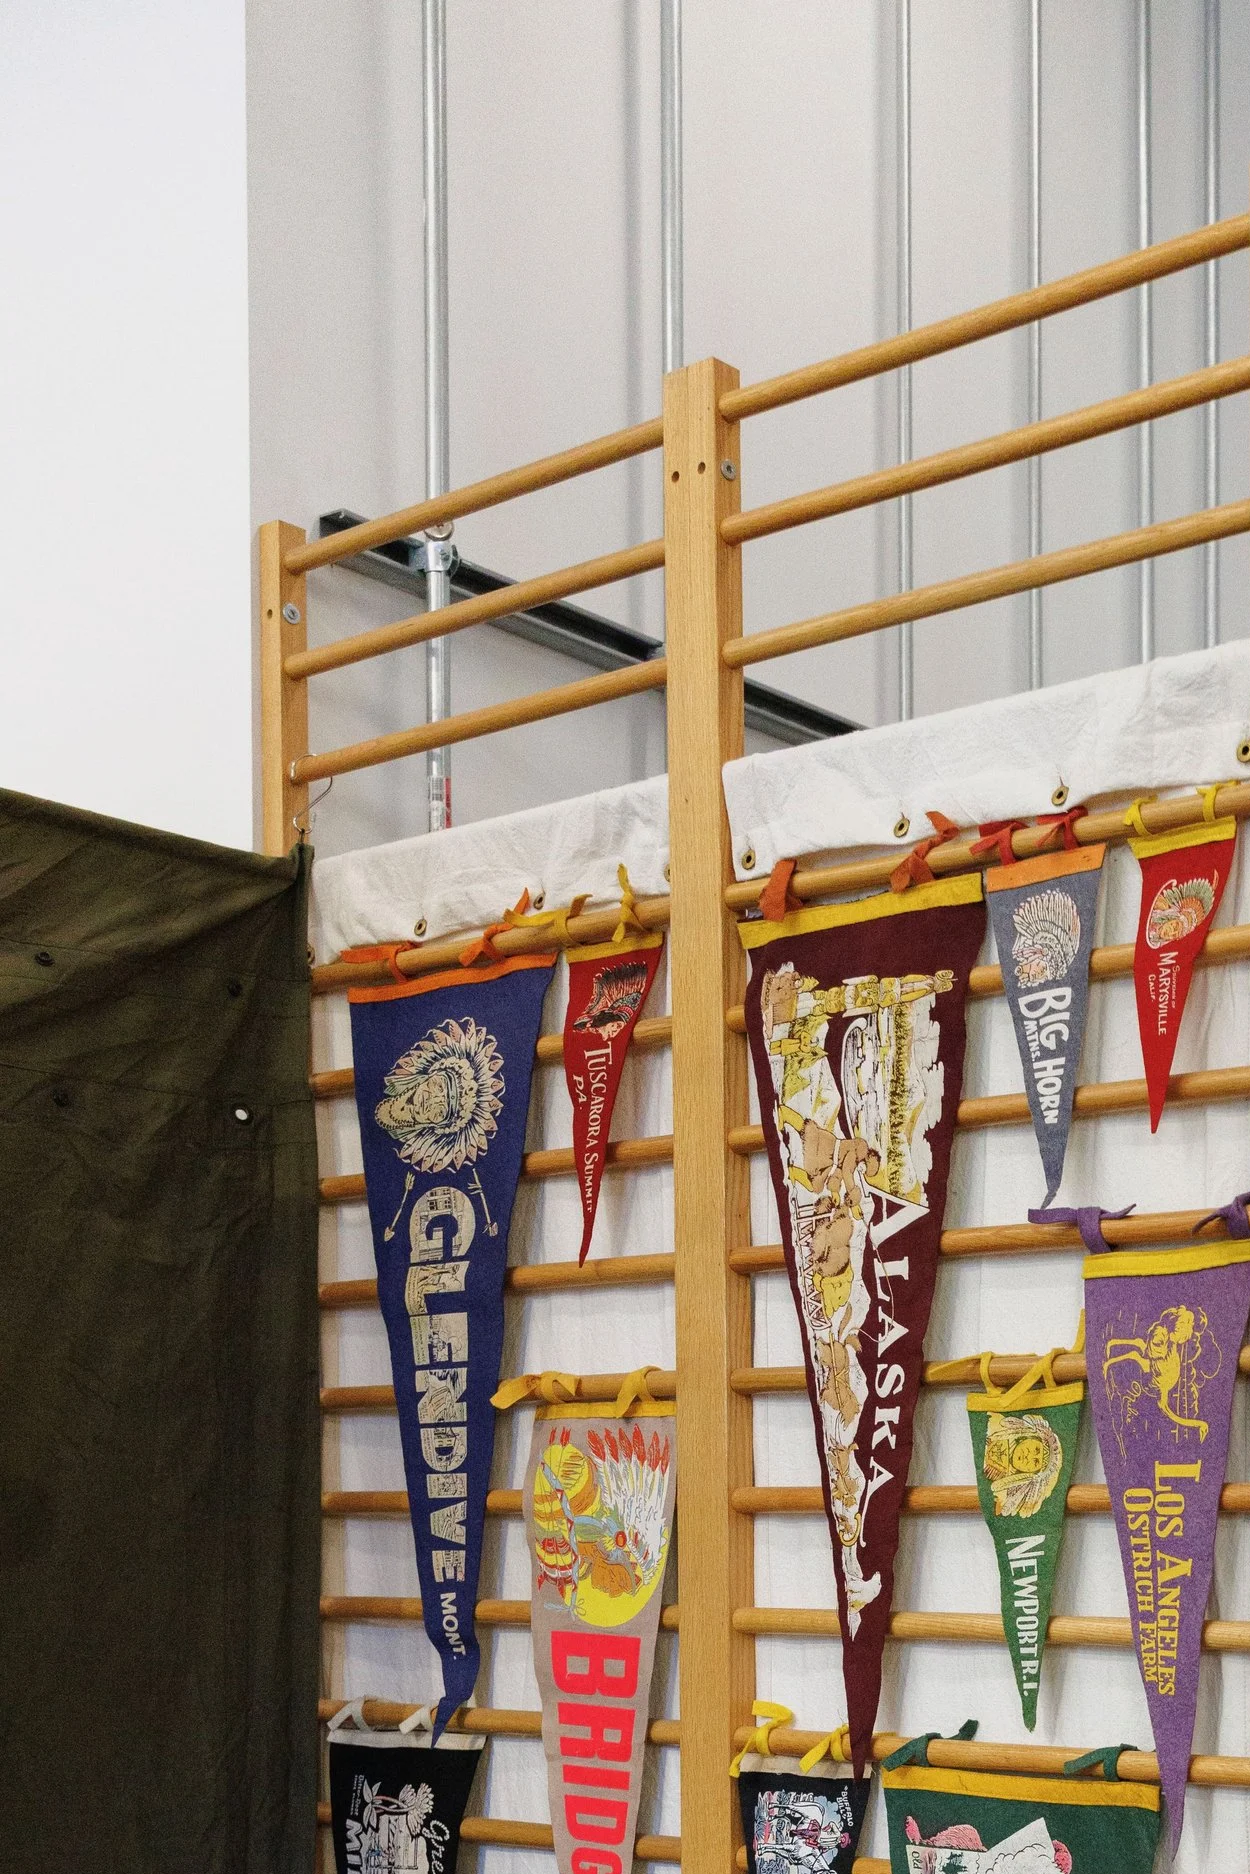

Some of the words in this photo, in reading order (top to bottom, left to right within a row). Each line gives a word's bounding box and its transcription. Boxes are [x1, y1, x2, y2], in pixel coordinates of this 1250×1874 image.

[1018, 986, 1072, 1051] BIG
[1158, 951, 1177, 1036] MARYSVILLE
[584, 1041, 613, 1149] TUSCARORA
[1034, 1056, 1065, 1125] HORN
[584, 1152, 599, 1212] SUMMIT
[862, 1181, 930, 1500] ALASKA
[404, 1186, 476, 1583] GLENDIVE
[440, 1592, 467, 1660] MONT.
[1153, 1459, 1202, 1538] LOS
[1005, 1535, 1046, 1656] NEWPORT
[1123, 1488, 1154, 1616] OSTRICH
[1134, 1620, 1159, 1682] FARM
[1154, 1550, 1192, 1696] ANGELES
